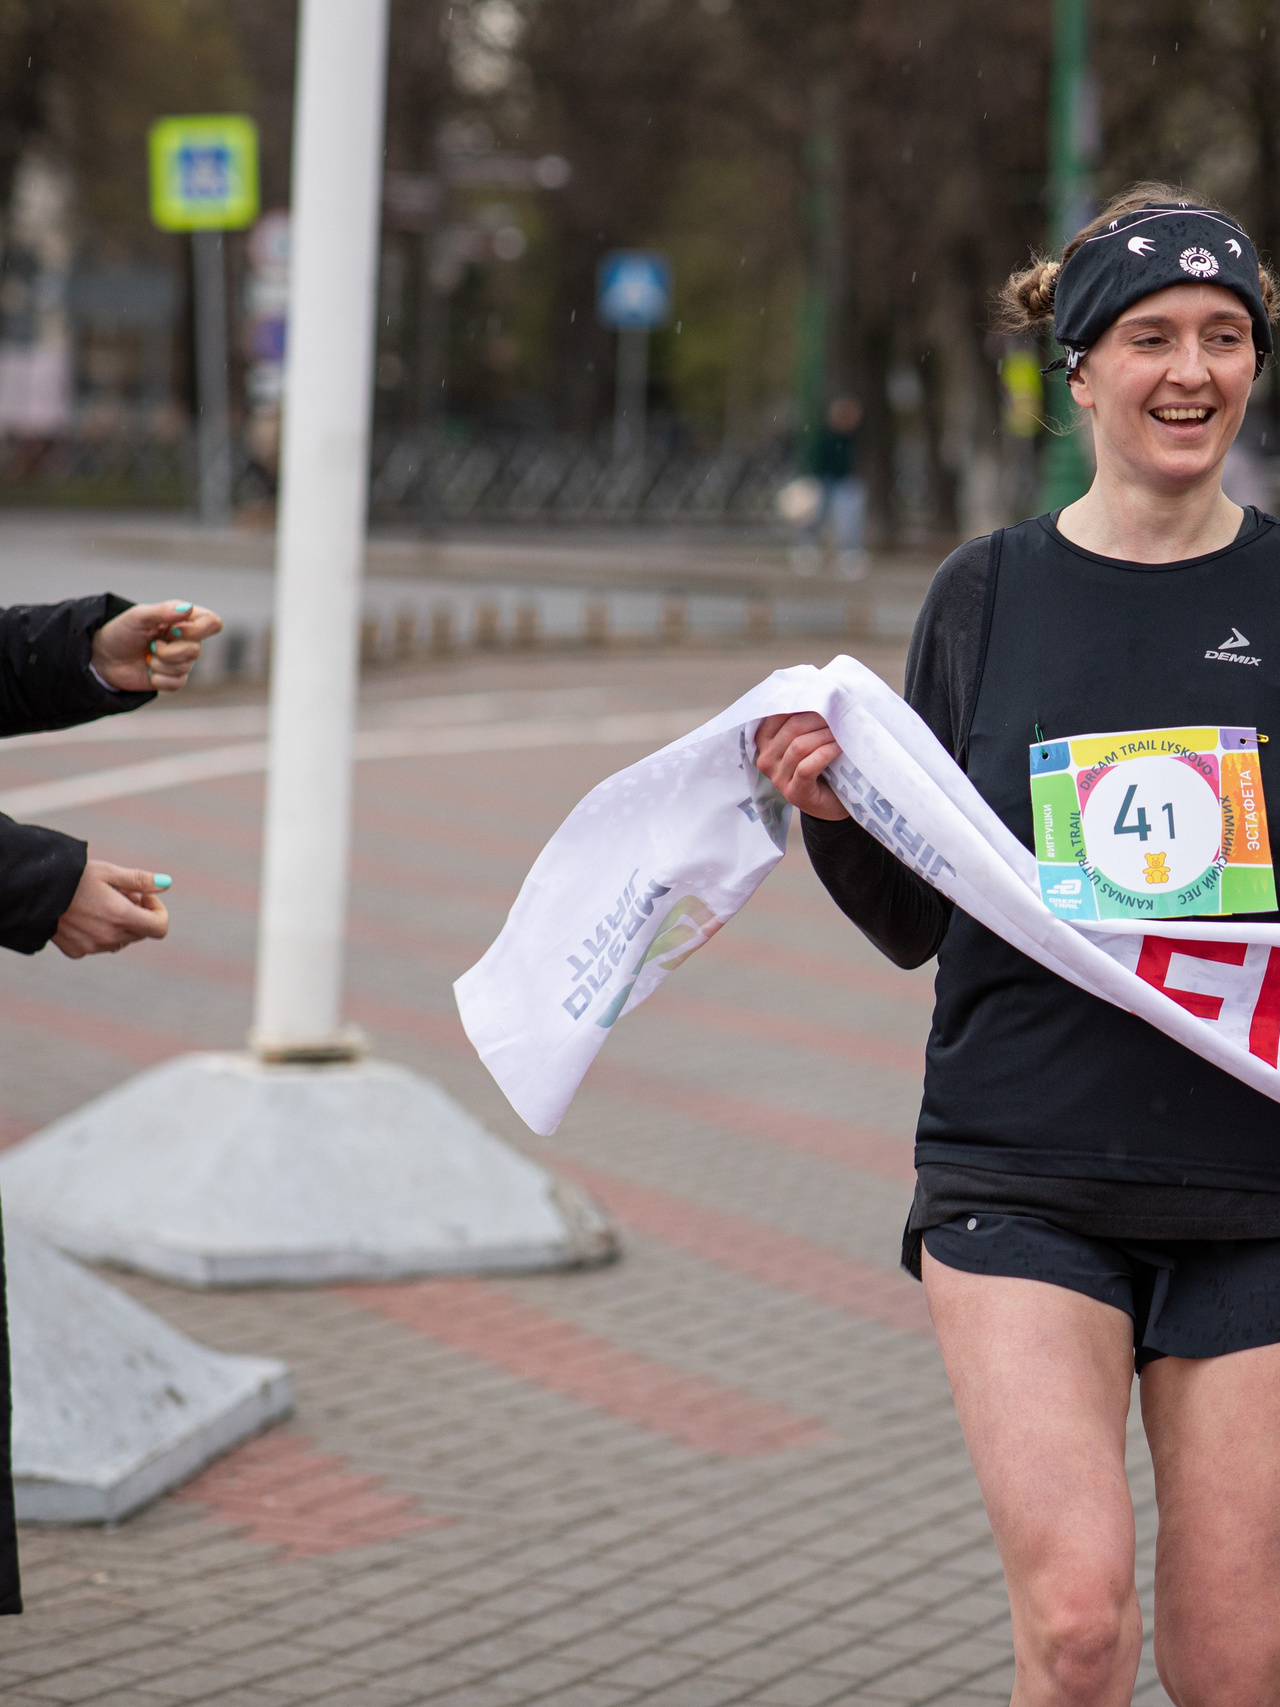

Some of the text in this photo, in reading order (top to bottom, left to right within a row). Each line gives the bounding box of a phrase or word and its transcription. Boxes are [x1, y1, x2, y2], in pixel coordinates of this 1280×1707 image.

[1204, 650, 1262, 667] DEMIX
[1080, 740, 1213, 791] DREAM TRAIL LYSKOVO
[1070, 810, 1081, 847] TRAIL
[1241, 769, 1260, 851] ЭСТАФЕТА
[1043, 803, 1056, 858] #ИГРУШКИ
[1099, 882, 1154, 911] KANNAS
[1177, 883, 1202, 906] ЛЕС
